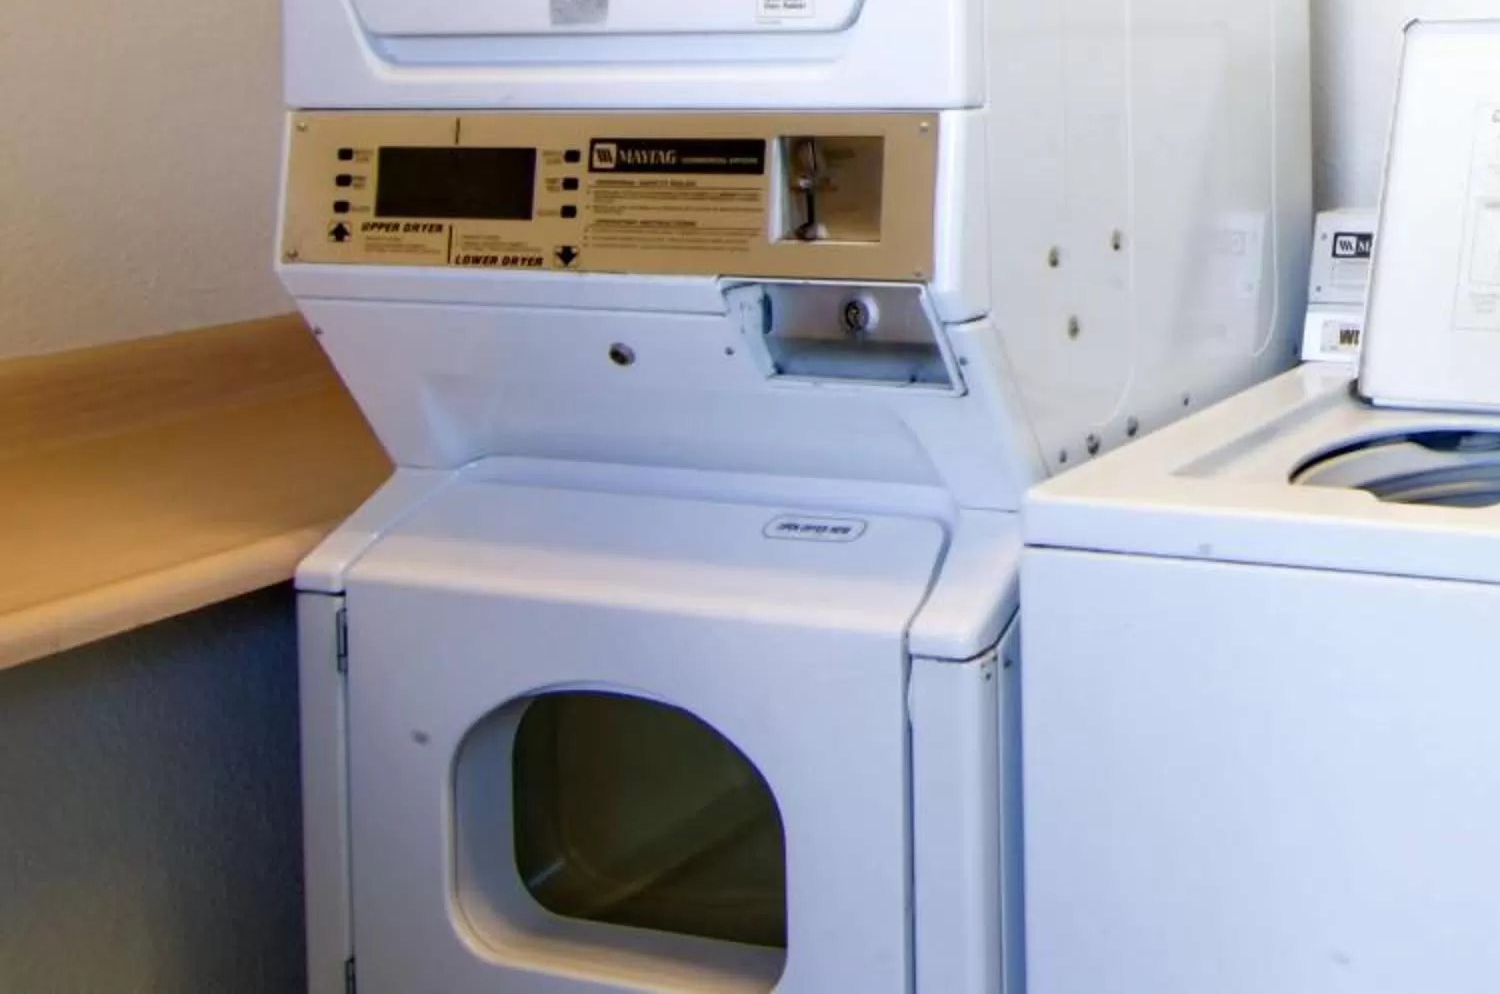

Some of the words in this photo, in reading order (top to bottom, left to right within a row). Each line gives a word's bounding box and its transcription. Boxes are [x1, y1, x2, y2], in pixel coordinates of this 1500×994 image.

[619, 148, 677, 165] MAYTAG
[361, 221, 400, 233] UPPER
[402, 222, 444, 234] DRYER
[455, 254, 498, 266] LOWER
[501, 255, 545, 267] DRYER
